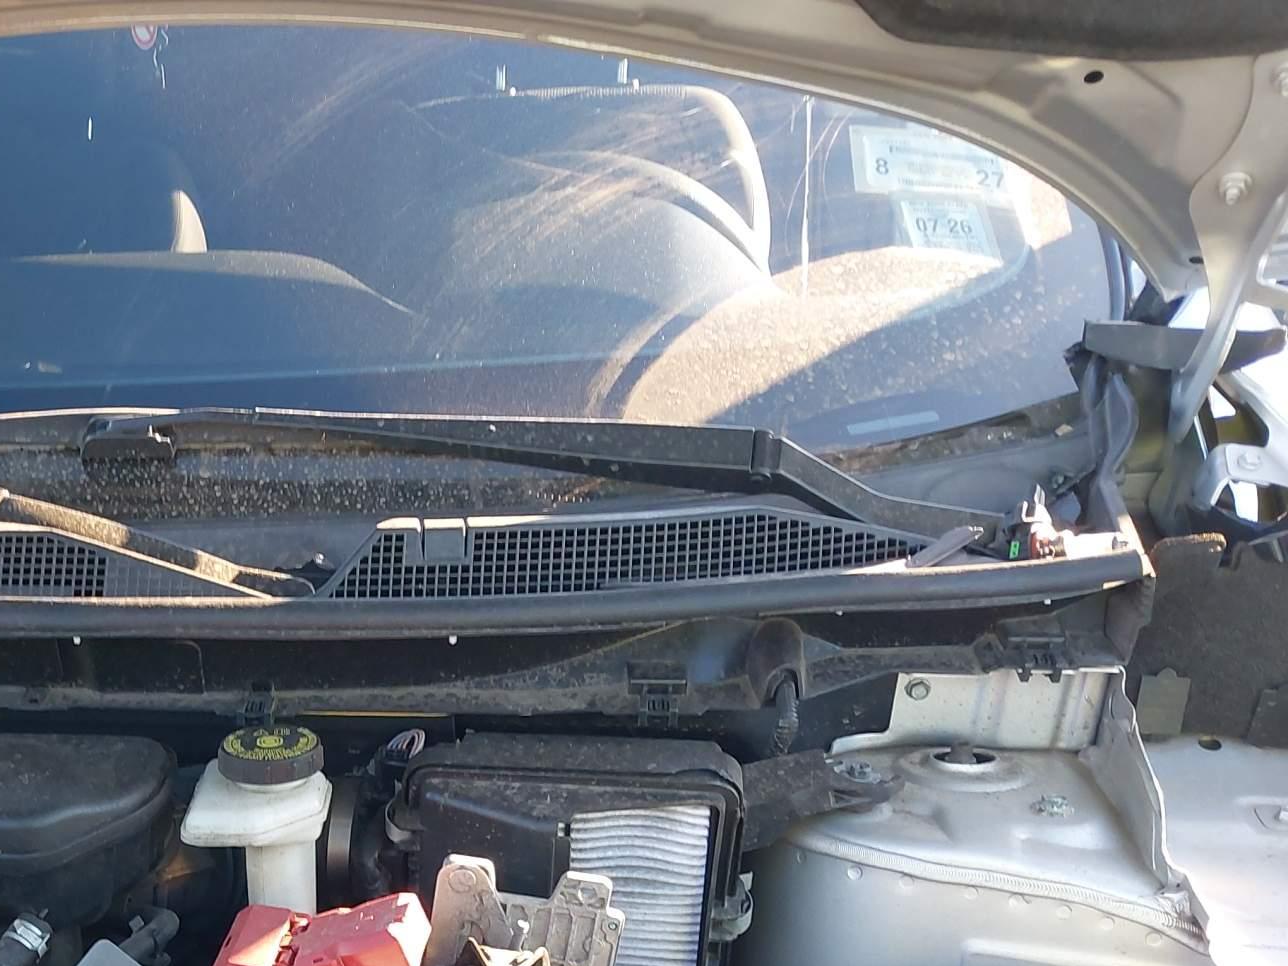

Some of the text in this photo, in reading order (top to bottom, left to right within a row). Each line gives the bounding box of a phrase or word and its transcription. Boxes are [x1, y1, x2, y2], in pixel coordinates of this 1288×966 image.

[875, 158, 889, 175] 8
[976, 169, 1004, 188] 27
[915, 217, 972, 234] 07 26
